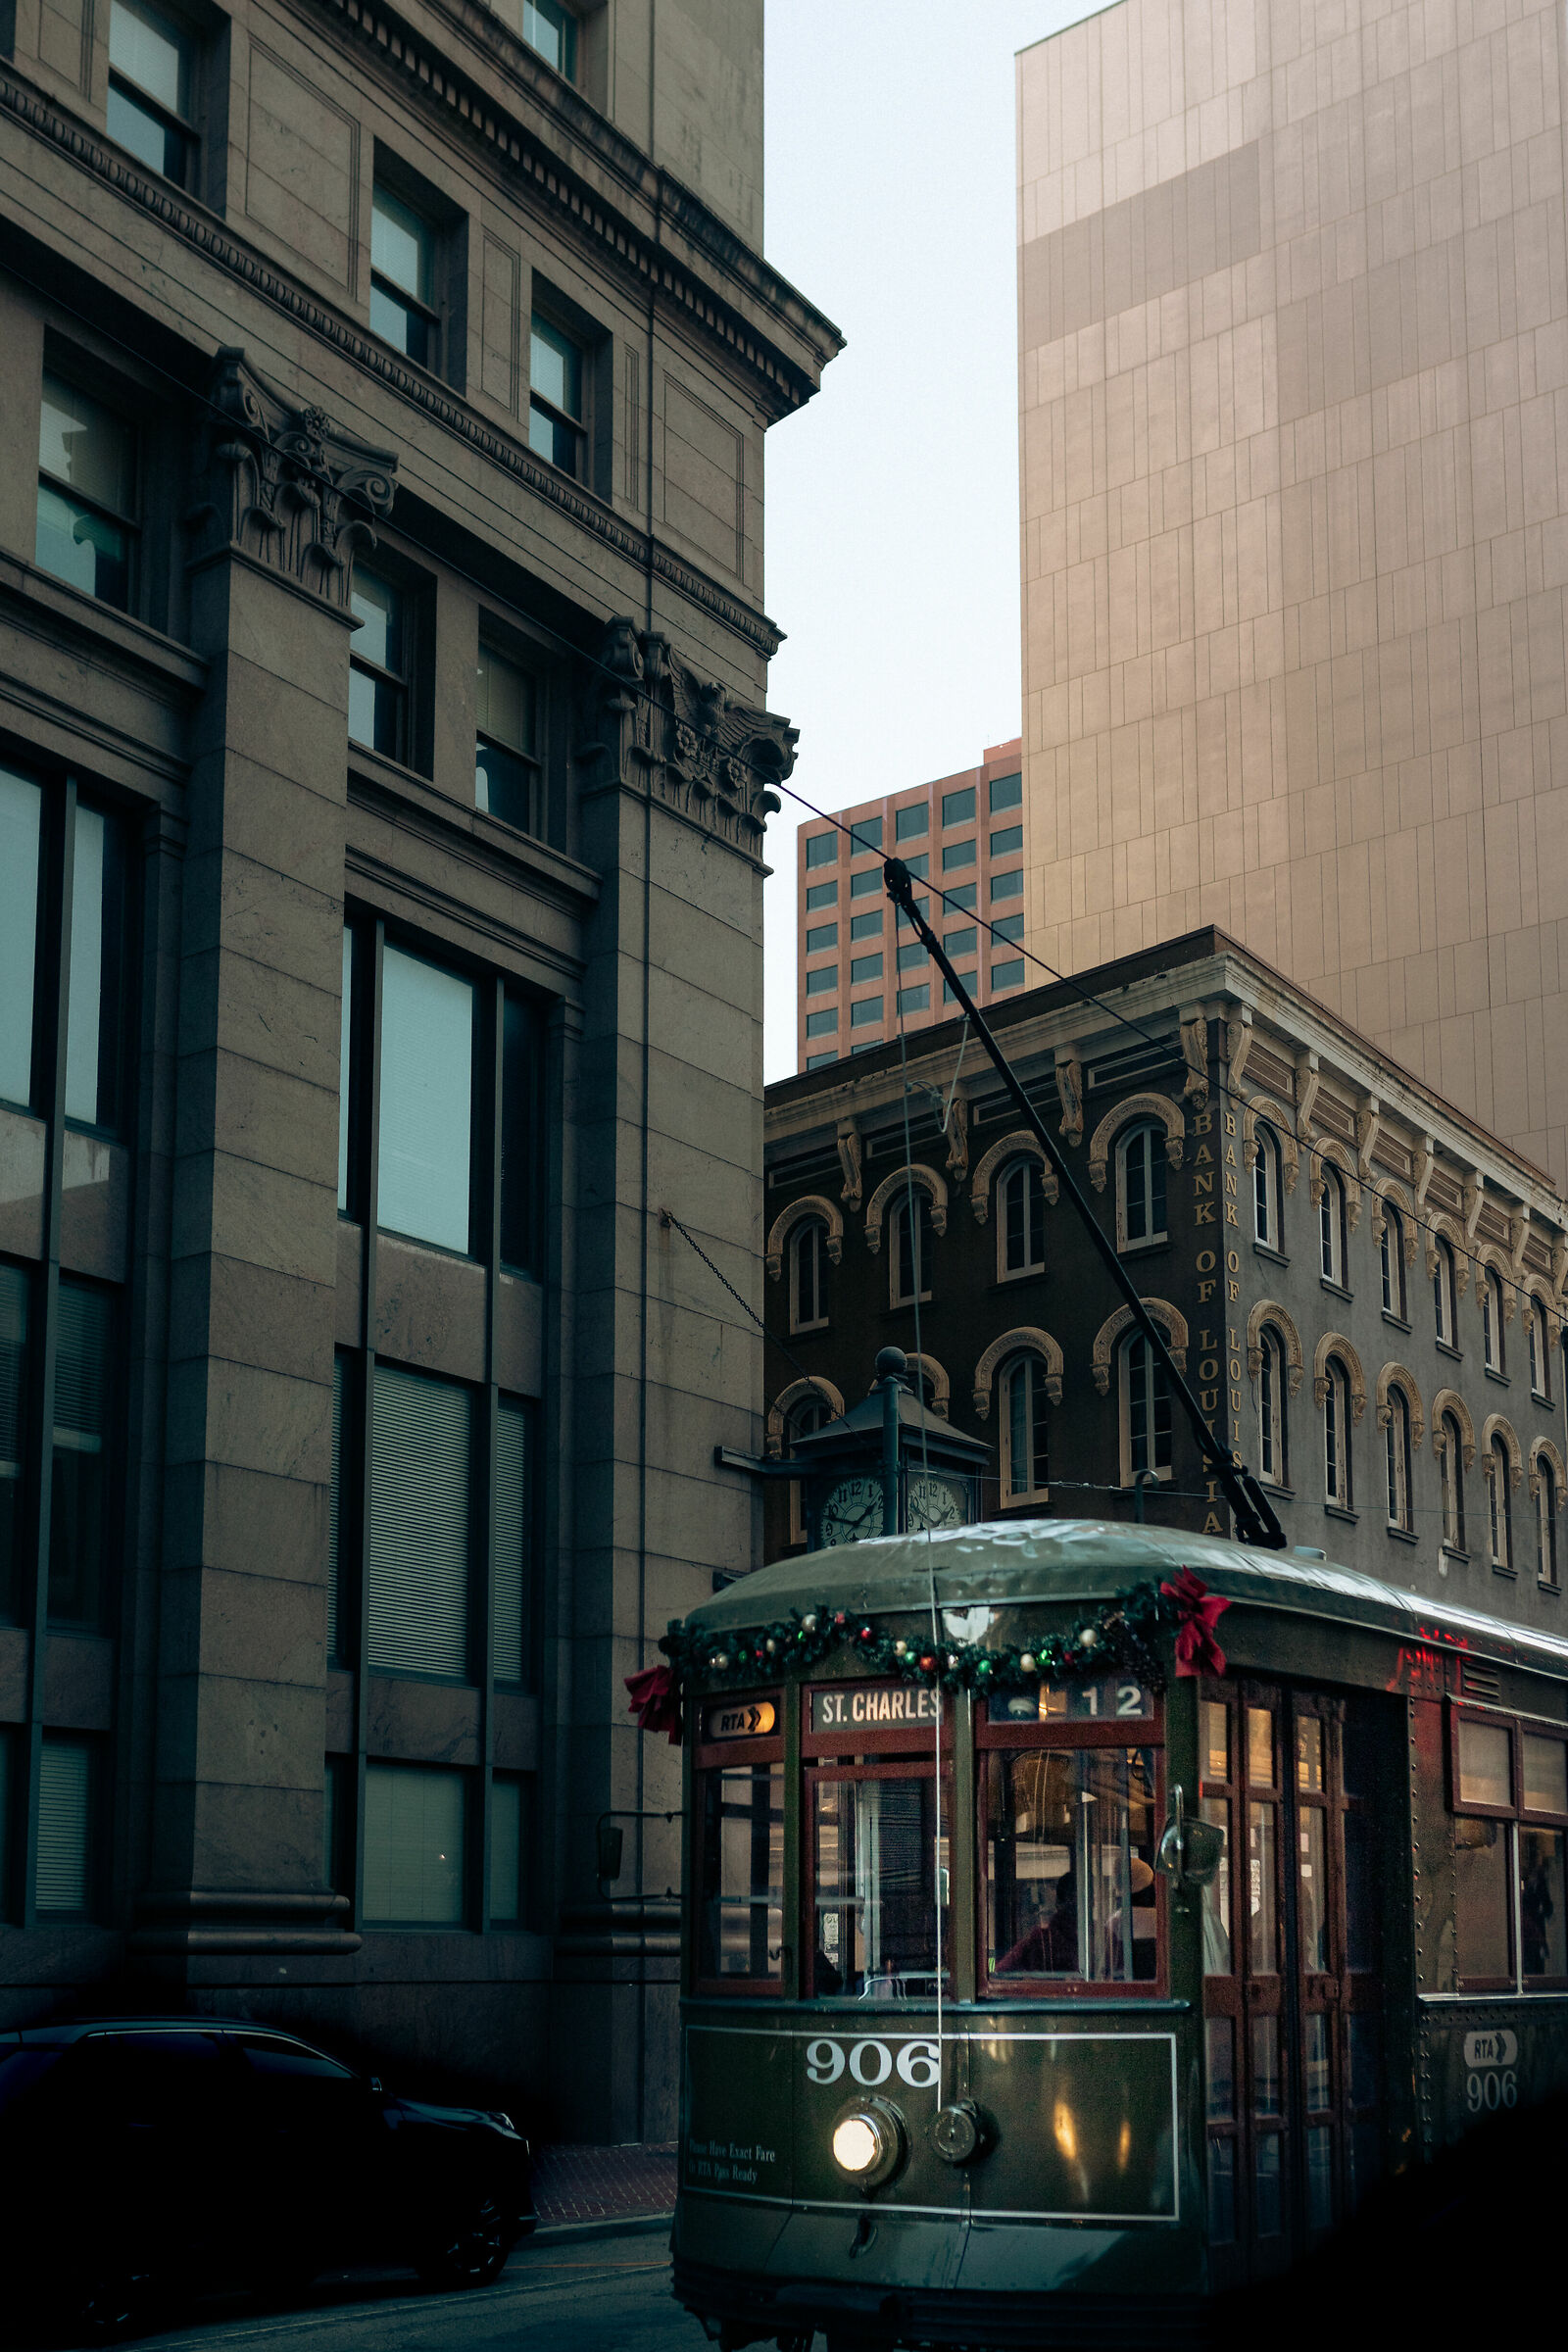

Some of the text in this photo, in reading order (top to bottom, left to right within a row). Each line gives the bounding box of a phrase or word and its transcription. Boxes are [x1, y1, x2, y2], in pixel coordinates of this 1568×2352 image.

[1193, 1113, 1216, 1227] BANK
[1225, 1112, 1239, 1228] BANK
[1196, 1250, 1216, 1303] OF
[1227, 1250, 1240, 1303] OF
[851, 1481, 861, 1496] 12
[929, 1483, 938, 1497] 12
[720, 1714, 745, 1732] RTA
[822, 1689, 944, 1724] ST. CHARLES
[807, 2038, 942, 2087] 906
[1474, 2039, 1494, 2060] RTA
[1467, 2070, 1517, 2112] 906
[729, 2142, 752, 2160] Exact
[756, 2144, 775, 2163] Fare
[732, 2164, 758, 2185] Ready
